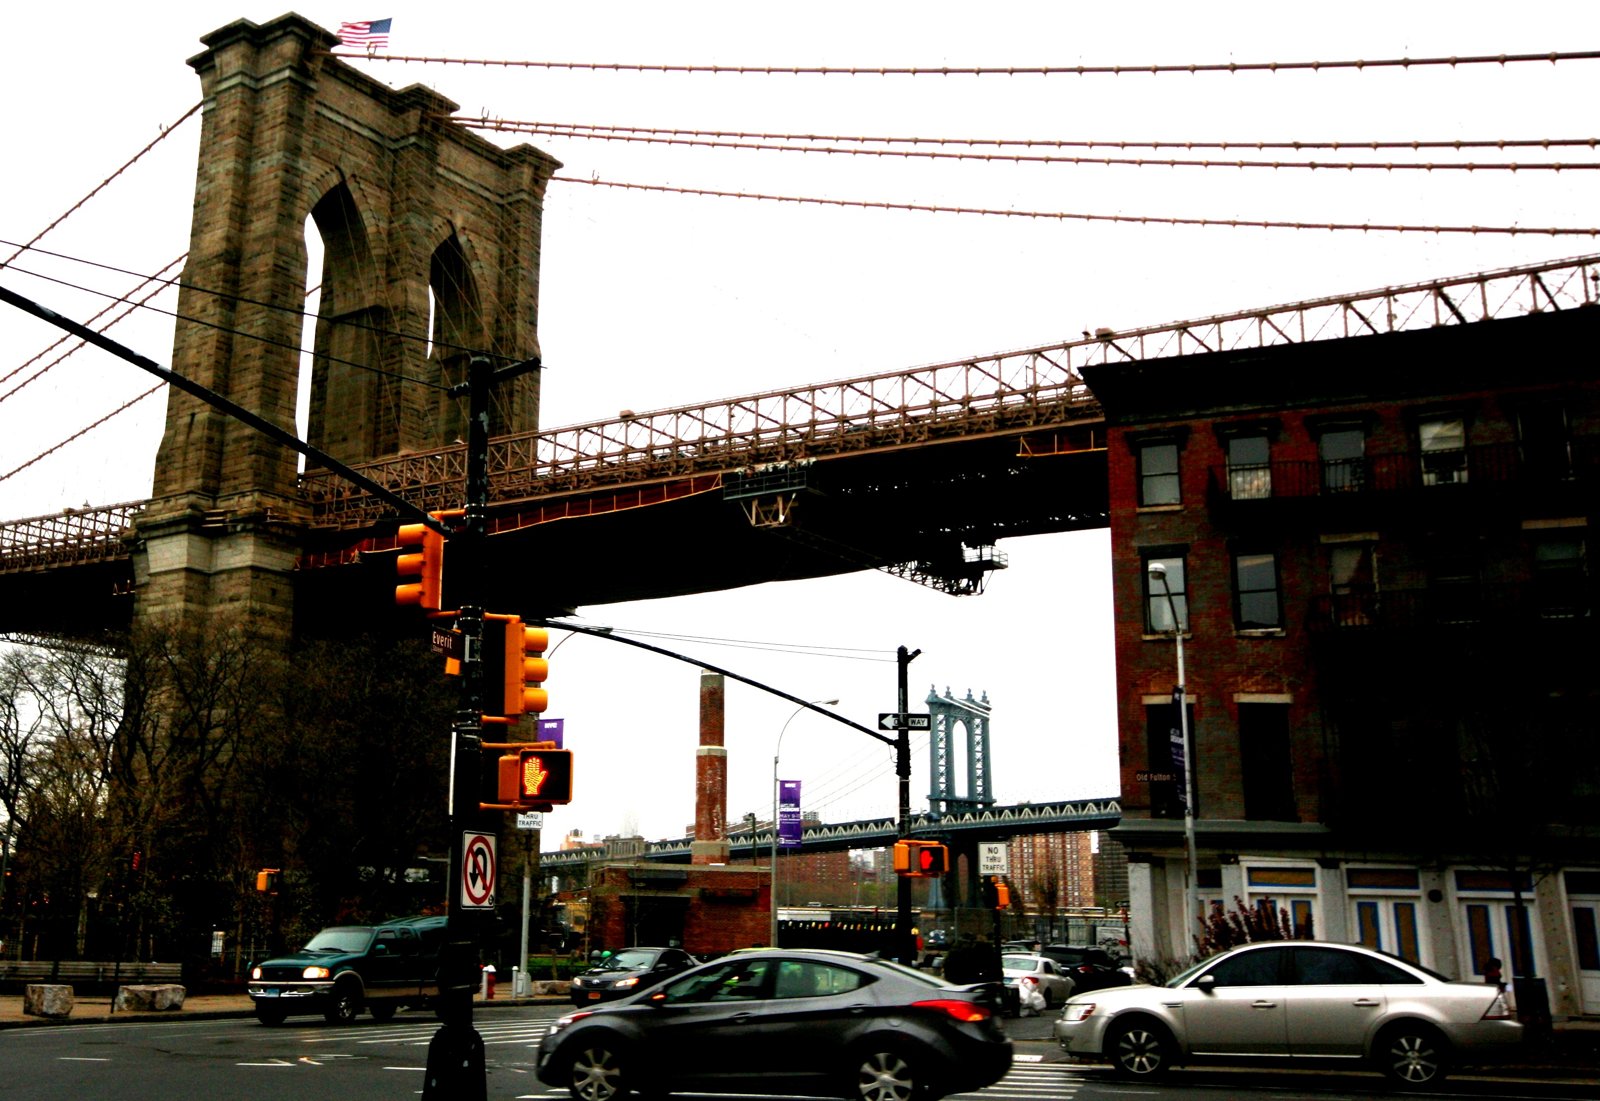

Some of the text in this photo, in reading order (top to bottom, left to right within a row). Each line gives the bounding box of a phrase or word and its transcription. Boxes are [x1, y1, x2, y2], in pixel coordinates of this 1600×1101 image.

[432, 631, 452, 649] Everit
[911, 718, 926, 726] WAY
[1136, 773, 1148, 781] Old
[1149, 773, 1171, 781] Fulton
[987, 847, 999, 855] NO
[982, 864, 1005, 872] TRAFFIC
